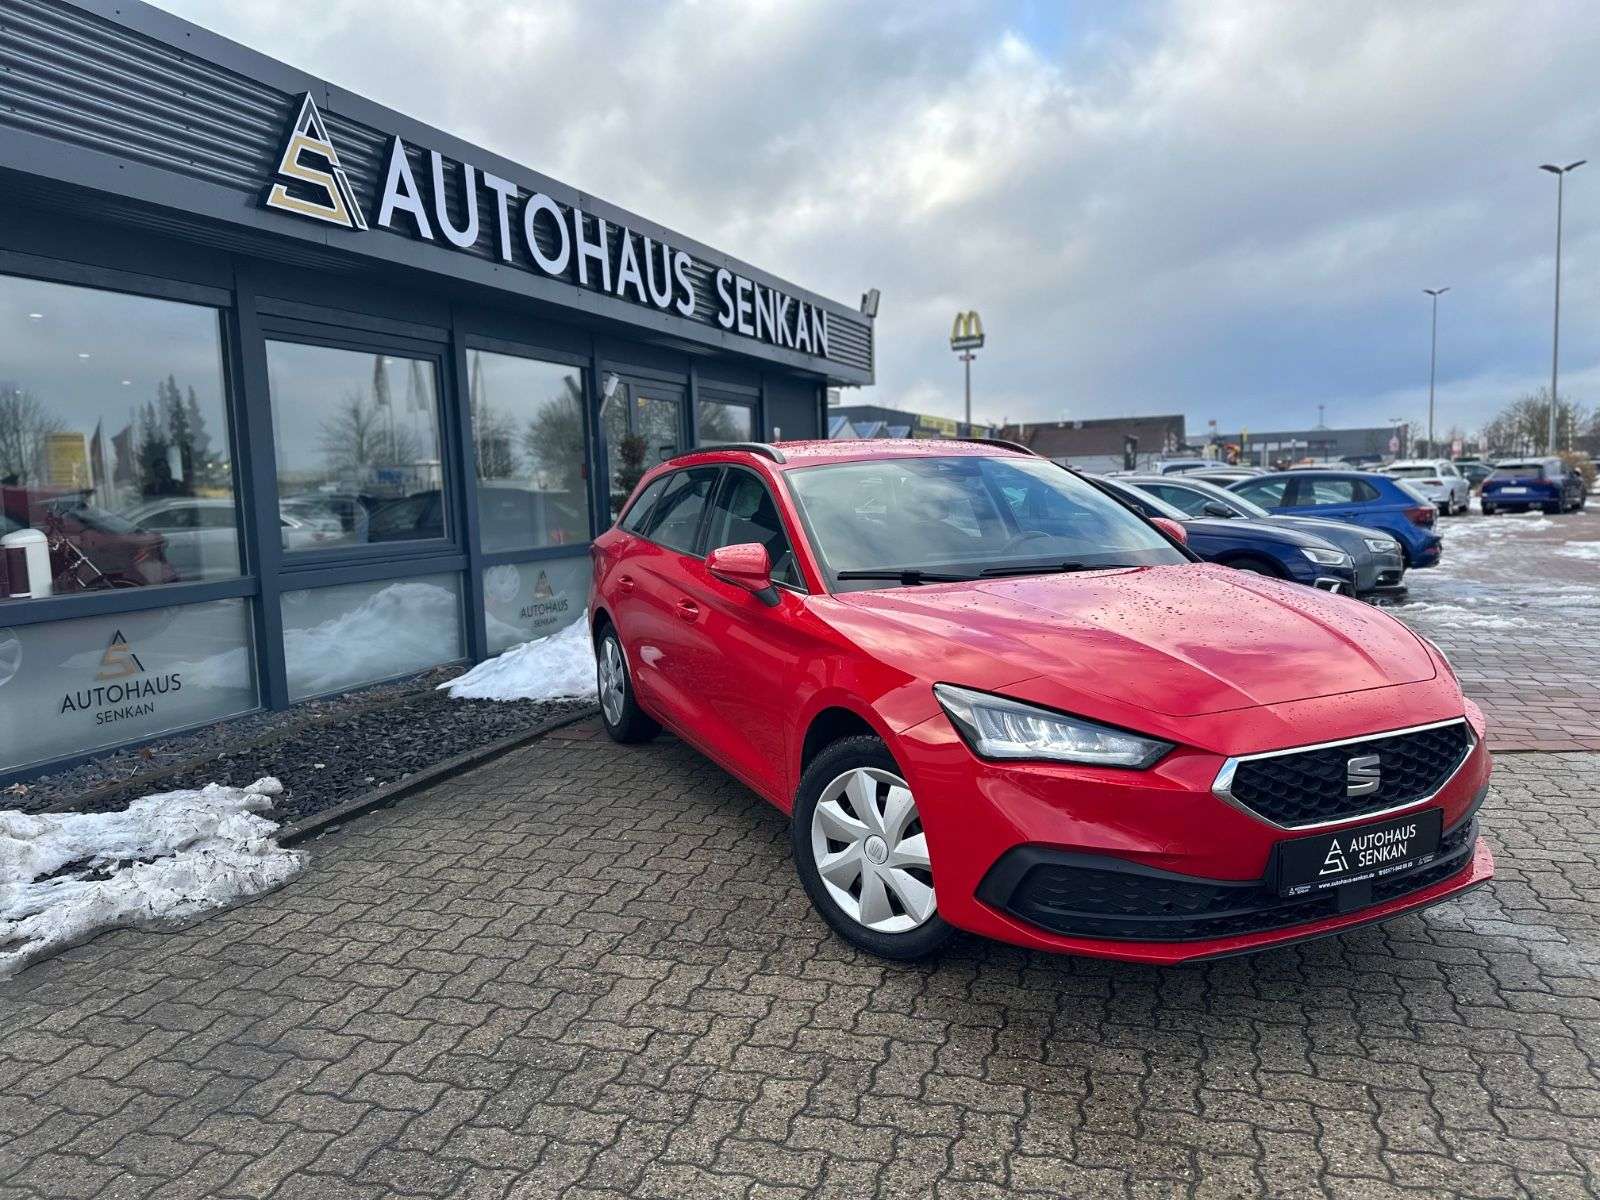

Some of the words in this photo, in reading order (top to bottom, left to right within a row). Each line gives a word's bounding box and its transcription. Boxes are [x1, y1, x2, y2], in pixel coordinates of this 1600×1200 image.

[377, 134, 698, 317] AUTOHAUS
[716, 267, 830, 358] SENKAN
[520, 598, 569, 618] AUTOHAUS
[61, 673, 182, 714] AUTOHAUS
[96, 702, 154, 725] SENKAN
[1349, 824, 1417, 853] AUTOHAUS
[1358, 841, 1408, 867] SENKAN
